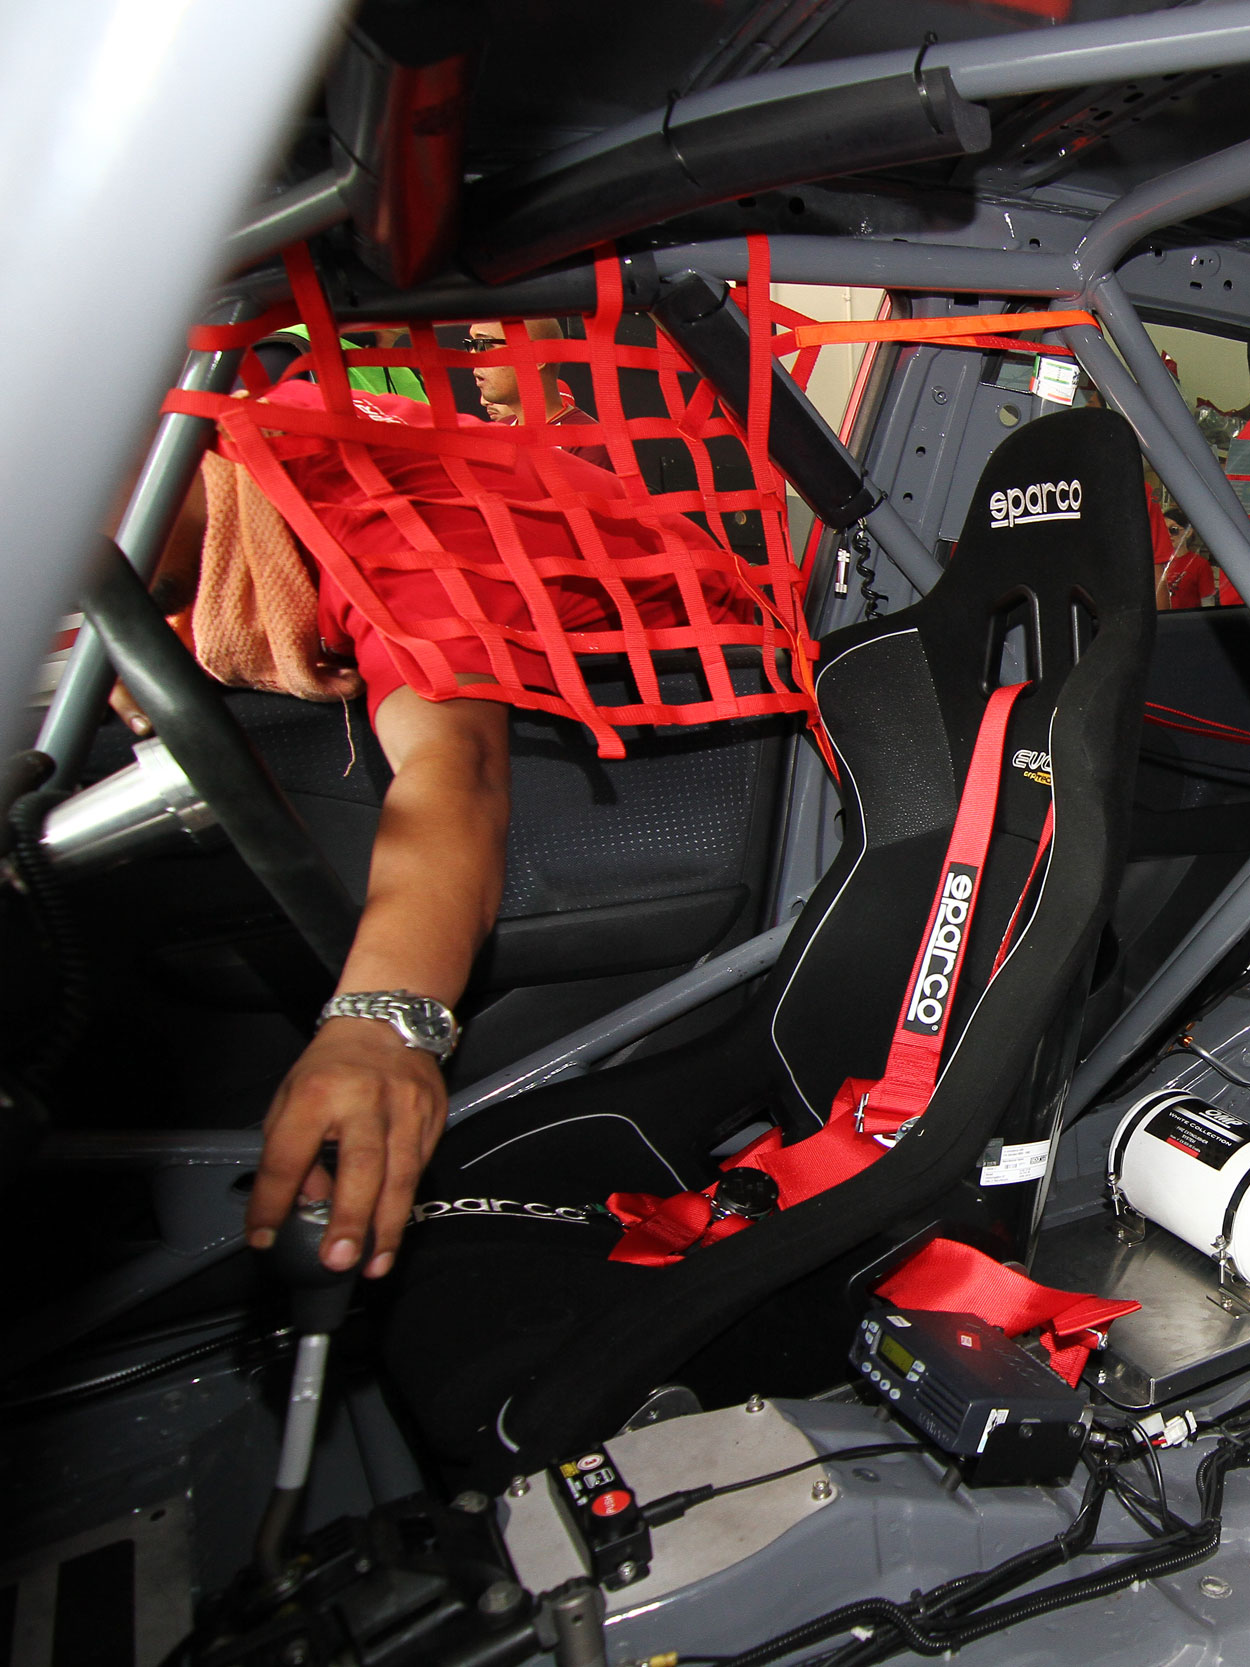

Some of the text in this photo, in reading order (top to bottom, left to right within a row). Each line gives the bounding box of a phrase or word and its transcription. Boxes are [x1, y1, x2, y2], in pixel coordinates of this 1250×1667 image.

[989, 479, 1082, 528] sparco
[913, 873, 973, 1026] sparco
[1168, 1111, 1190, 1125] WHITE
[1189, 1122, 1232, 1147] COLLECTION
[1205, 1108, 1244, 1126] OMP
[410, 1198, 587, 1223] parco
